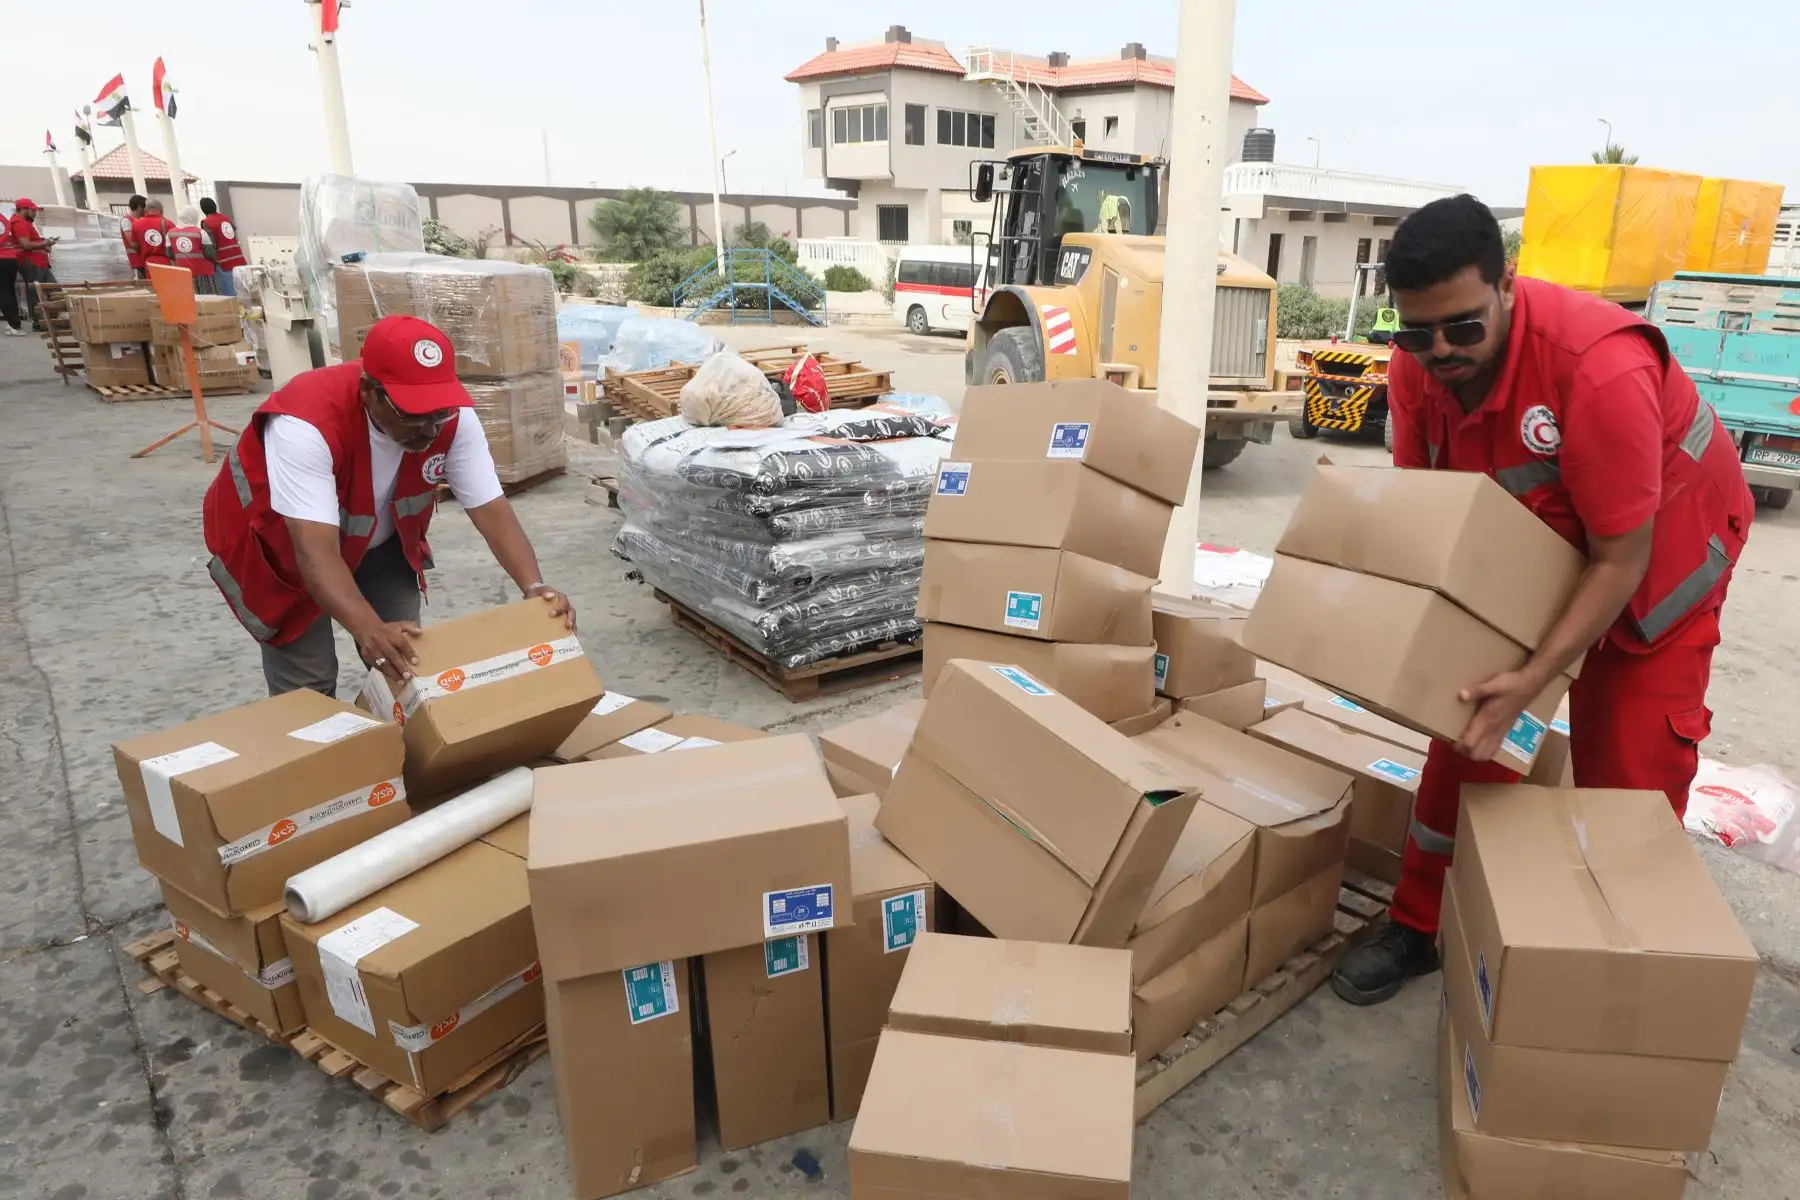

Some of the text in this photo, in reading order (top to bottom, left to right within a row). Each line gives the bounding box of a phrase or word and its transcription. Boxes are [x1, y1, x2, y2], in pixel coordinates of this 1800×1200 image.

[1060, 252, 1080, 279] CAT
[1754, 450, 1770, 461] RP
[439, 673, 463, 689] gsk
[530, 648, 553, 663] gsk
[371, 786, 395, 804] gsk
[271, 822, 297, 841] gsk
